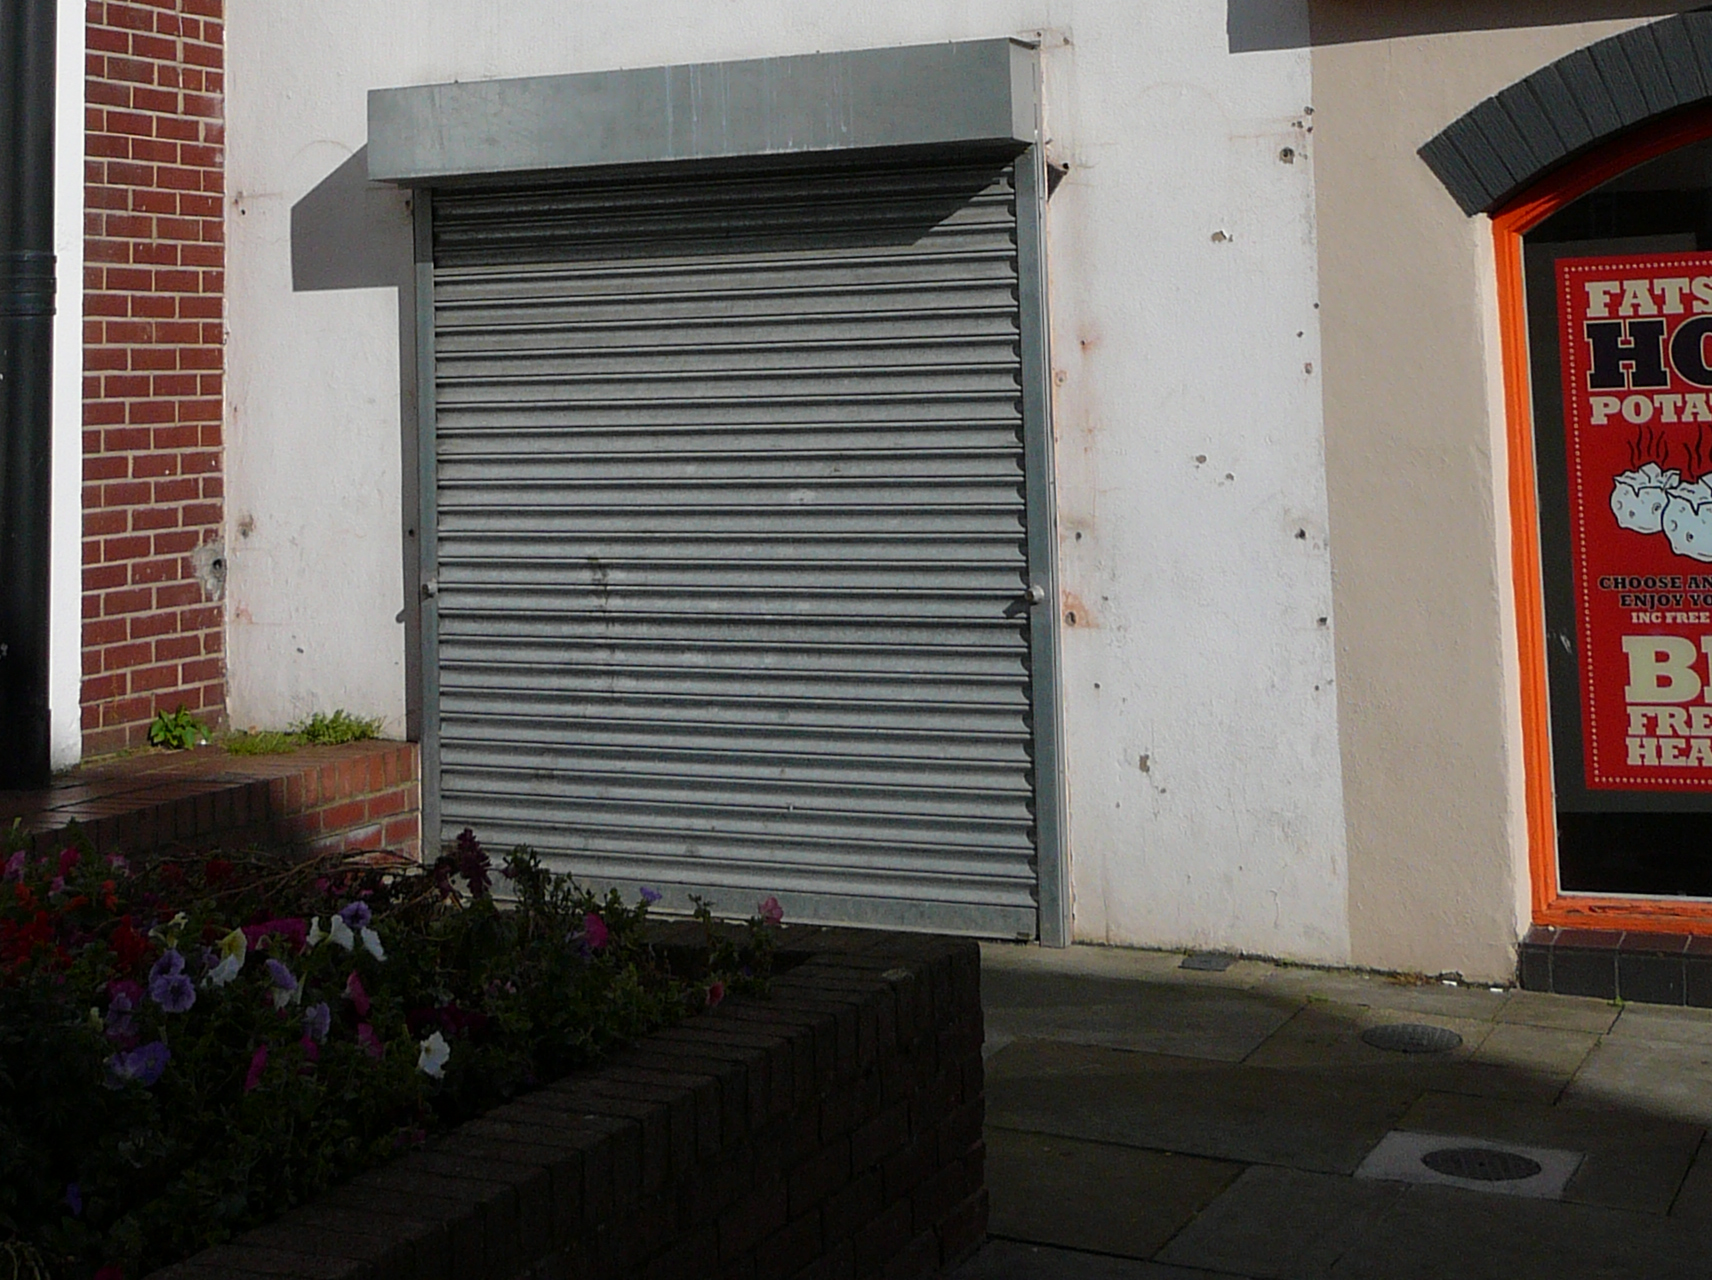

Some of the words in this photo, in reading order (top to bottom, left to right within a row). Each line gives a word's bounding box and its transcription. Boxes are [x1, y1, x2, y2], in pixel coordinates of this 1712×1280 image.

[1584, 276, 1712, 317] FATS
[1589, 393, 1712, 425] POTA
[1598, 575, 1683, 590] CHOOSE
[1619, 593, 1684, 611] ENJOY
[1631, 612, 1662, 624] INC
[1665, 612, 1711, 624] FREE
[1621, 635, 1712, 703] B
[1626, 706, 1712, 736] FRE
[1625, 737, 1712, 767] HEA
